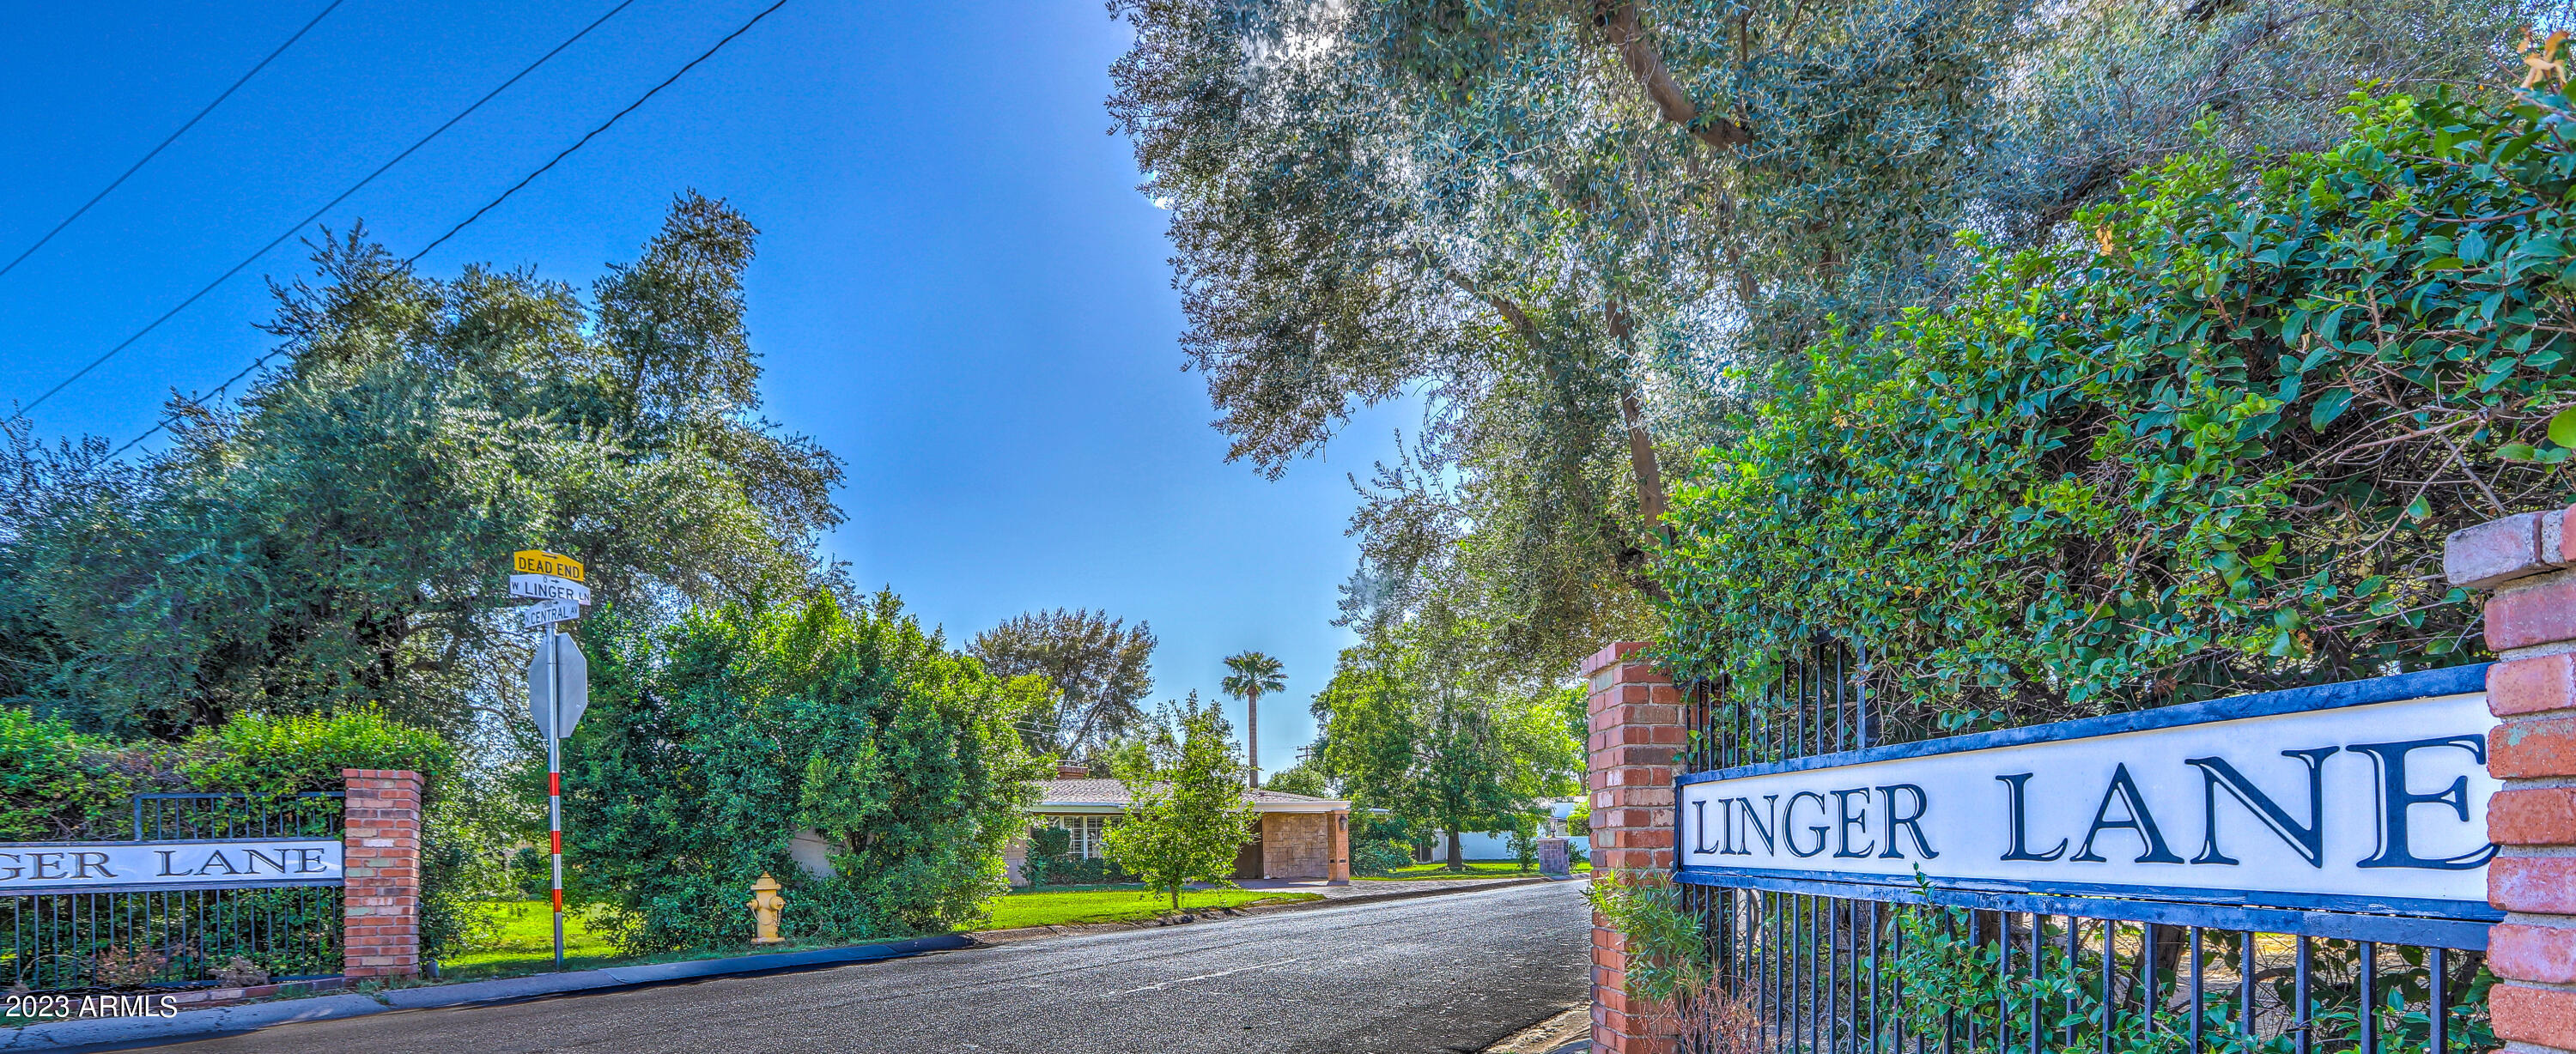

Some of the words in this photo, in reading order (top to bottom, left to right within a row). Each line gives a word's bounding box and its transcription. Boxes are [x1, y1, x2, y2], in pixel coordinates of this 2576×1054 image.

[519, 557, 552, 573] DEAD
[557, 563, 580, 578] END
[525, 582, 574, 600] LINGER
[579, 592, 589, 601] LN
[531, 606, 568, 625] CENTRAL
[1692, 782, 1939, 860] LINGER
[1996, 734, 2501, 870] LANE
[154, 847, 328, 877] LANE
